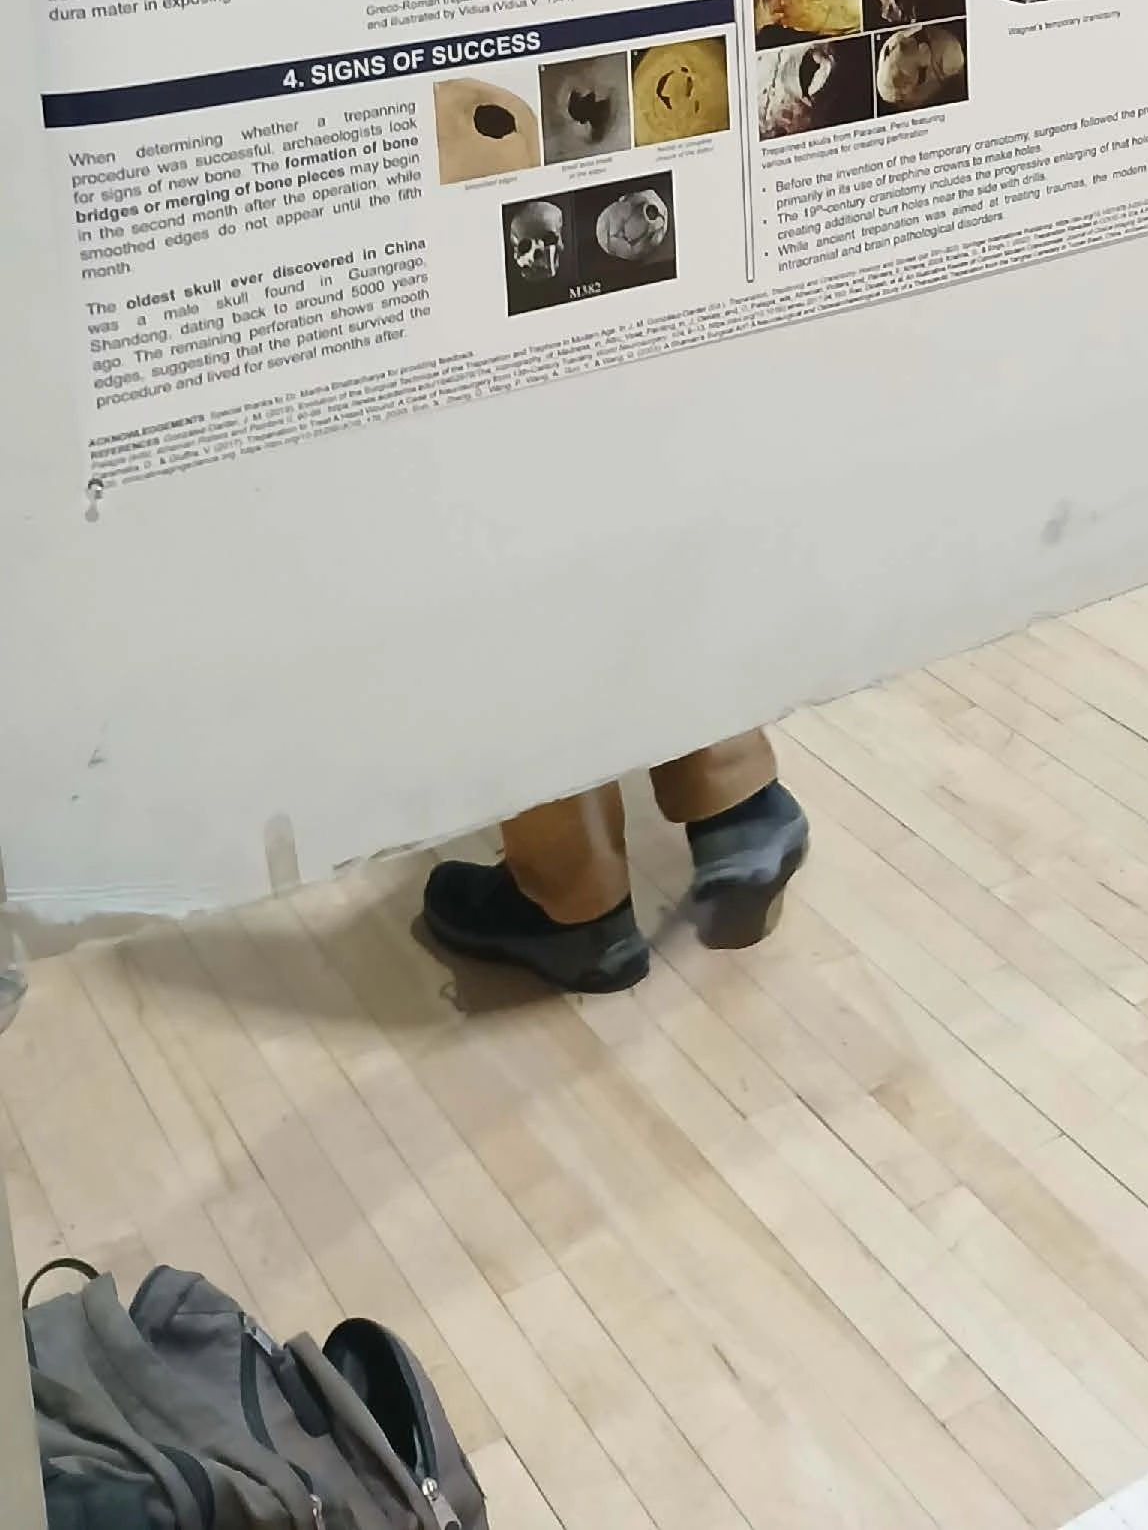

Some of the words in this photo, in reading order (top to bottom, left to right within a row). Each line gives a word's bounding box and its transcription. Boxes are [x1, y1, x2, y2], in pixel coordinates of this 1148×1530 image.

[283, 69, 304, 88] 4.
[311, 56, 385, 84] SIGNS
[393, 49, 424, 71] OF
[432, 32, 540, 65] SUCCESS
[87, 303, 116, 315] The
[127, 290, 175, 309] oldest
[184, 279, 221, 297] skull
[231, 273, 263, 287] ever
[273, 251, 354, 279] discovered
[363, 249, 376, 260] in
[385, 240, 426, 255] China
